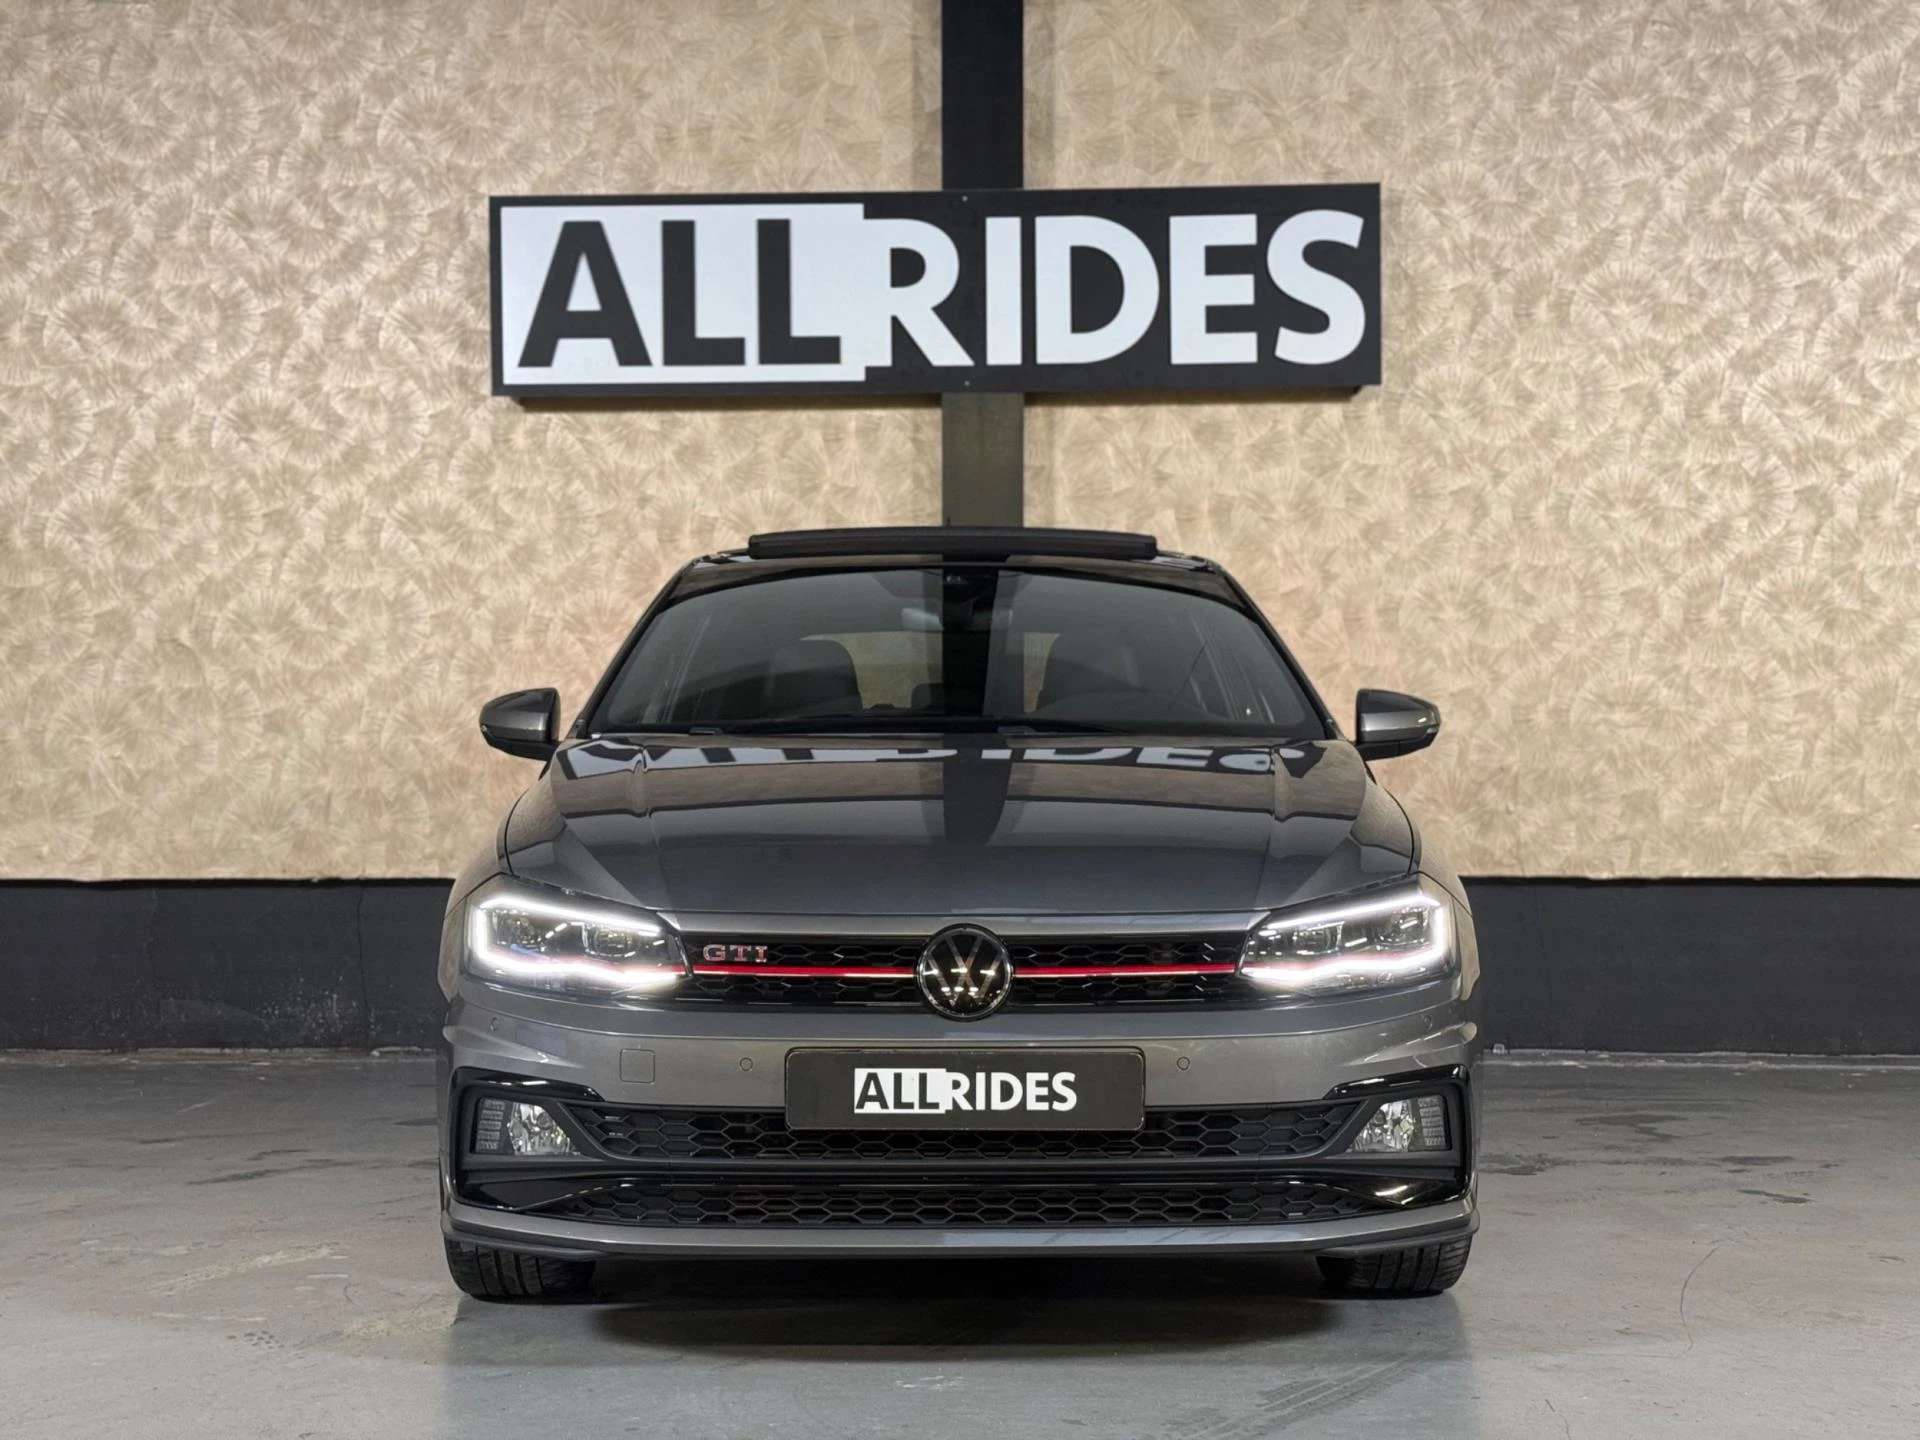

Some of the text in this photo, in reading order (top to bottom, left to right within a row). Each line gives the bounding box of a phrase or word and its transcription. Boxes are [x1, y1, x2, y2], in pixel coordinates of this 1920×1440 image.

[517, 209, 1366, 368] ALLRIDES
[702, 943, 768, 963] GTI
[855, 1071, 1078, 1112] ALLRIDES
